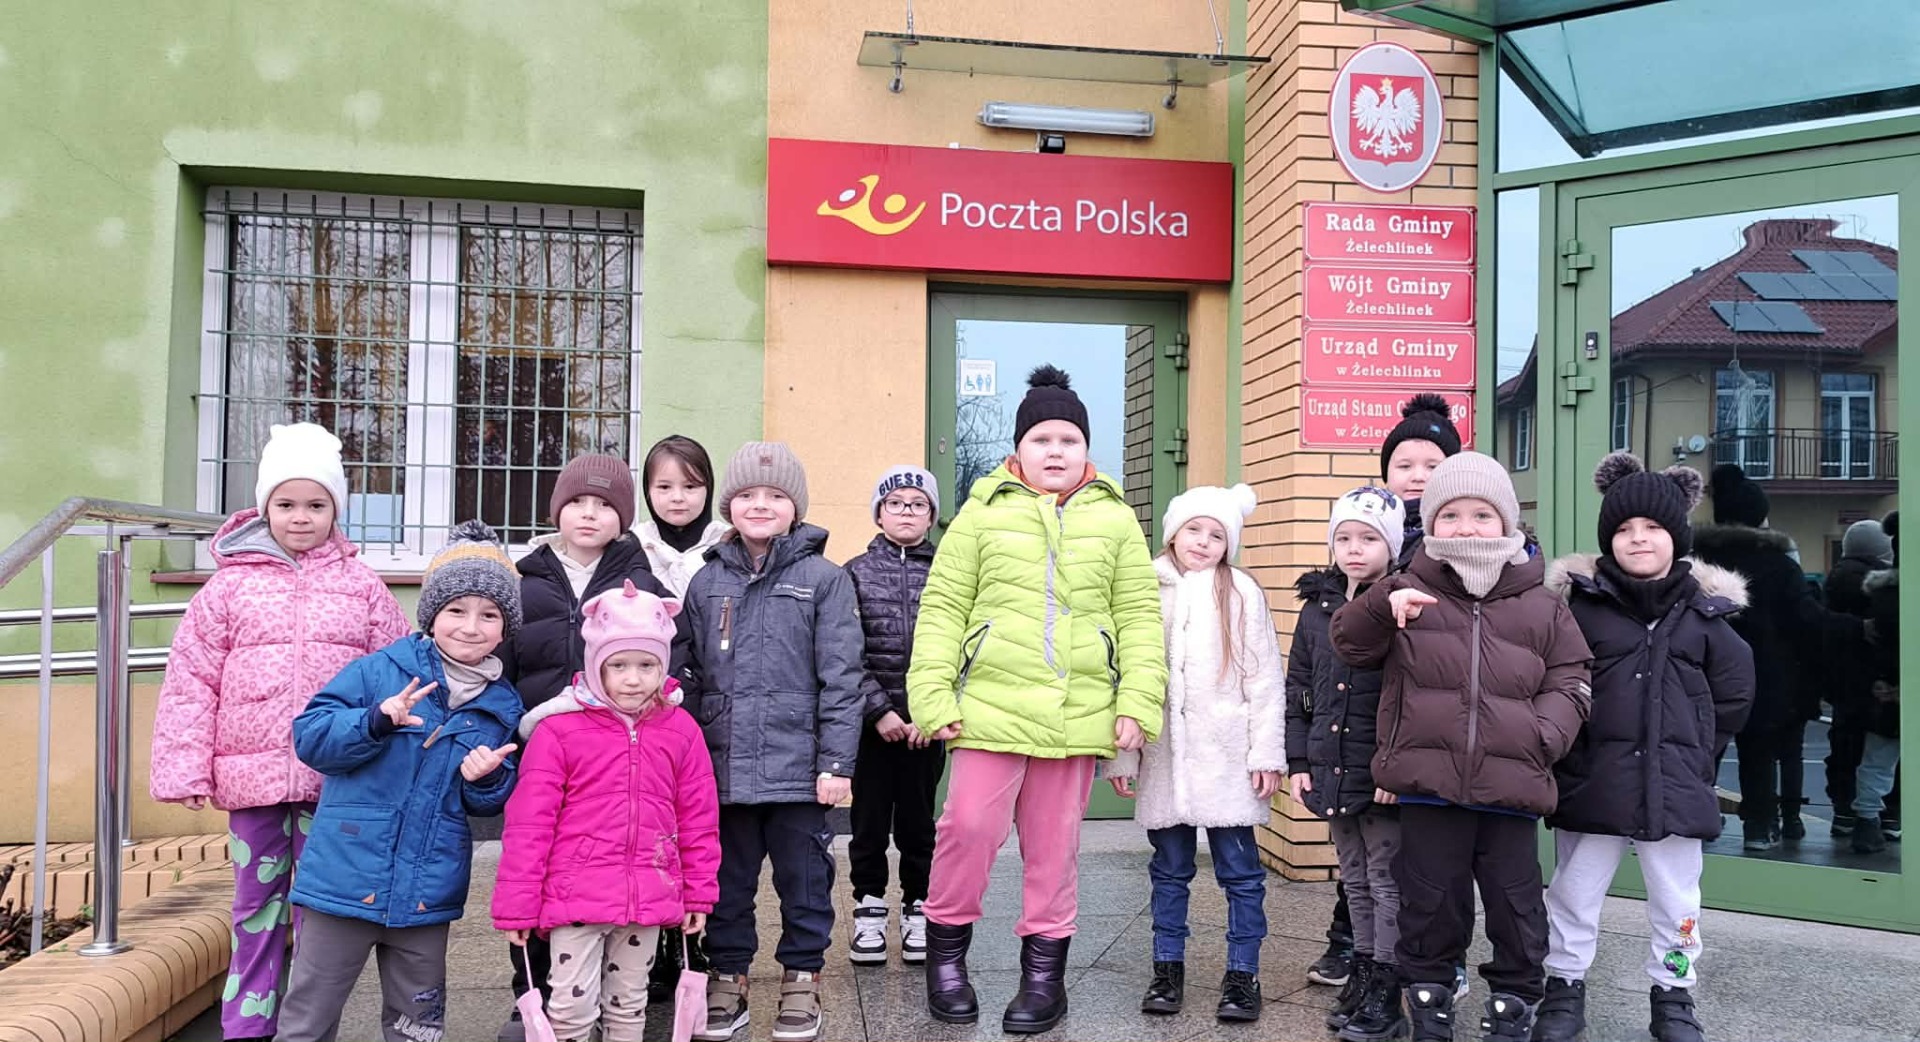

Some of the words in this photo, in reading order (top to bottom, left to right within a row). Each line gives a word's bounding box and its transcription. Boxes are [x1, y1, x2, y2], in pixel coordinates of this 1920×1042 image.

[941, 192, 1062, 231] Poczta
[1075, 199, 1188, 237] Polska
[1326, 213, 1376, 231] Rada
[1388, 215, 1454, 239] Gminy
[1346, 238, 1433, 254] Żelechlinek
[1328, 275, 1373, 297] Wójt
[1387, 277, 1452, 300] Gminy
[1346, 300, 1433, 316] Żelechlinek
[1320, 337, 1379, 358] Urząd
[1392, 339, 1458, 361] Gminy
[1336, 367, 1347, 375] w
[1352, 362, 1442, 377] Żelechlinku
[1308, 398, 1347, 419] Urząd
[1351, 400, 1392, 417] Stanu
[1335, 428, 1346, 437] w
[879, 472, 924, 496] GUESS
